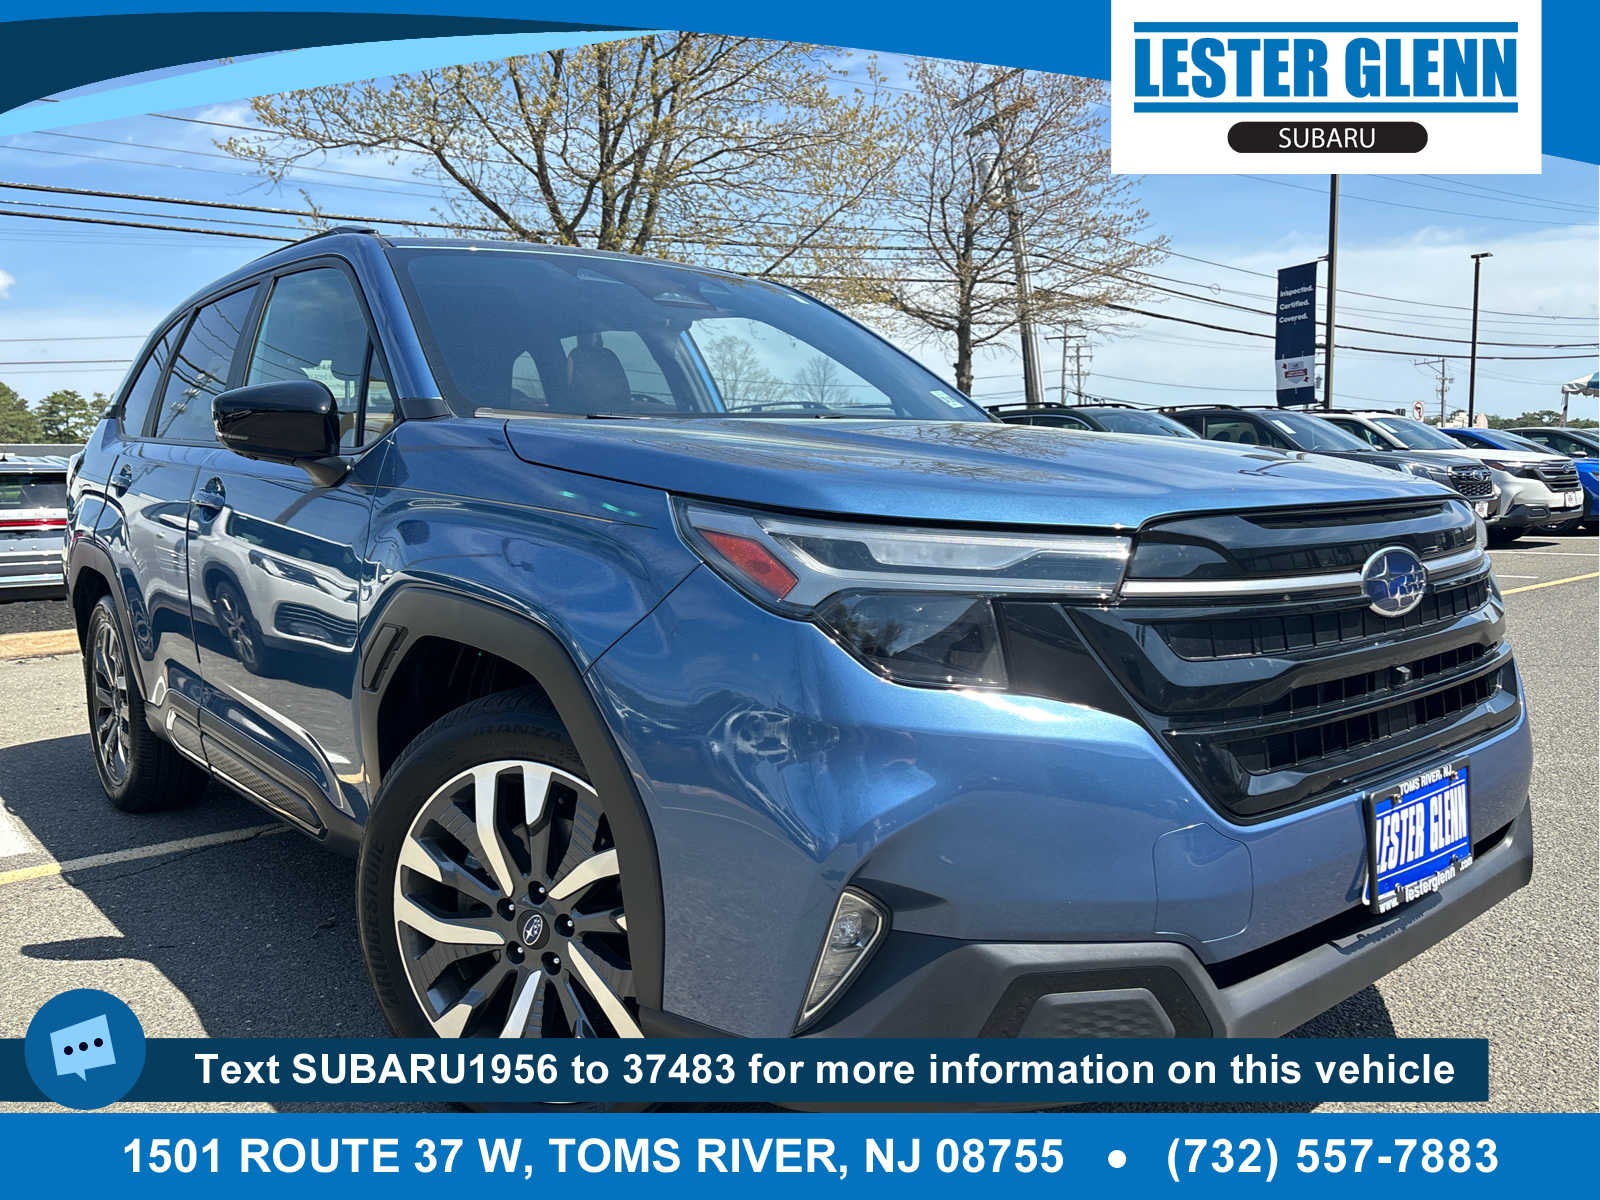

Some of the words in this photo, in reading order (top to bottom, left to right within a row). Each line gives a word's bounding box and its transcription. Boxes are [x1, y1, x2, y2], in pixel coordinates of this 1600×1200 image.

[1279, 284, 1314, 297] Inspected.
[1279, 299, 1310, 311] Certified.
[1278, 312, 1309, 324] Covered.
[1399, 777, 1420, 795] TOMS
[1442, 763, 1452, 778] NJ
[1376, 801, 1425, 875] LESTER
[1429, 783, 1467, 853] GLENN
[1405, 865, 1456, 903] lesterglenn
